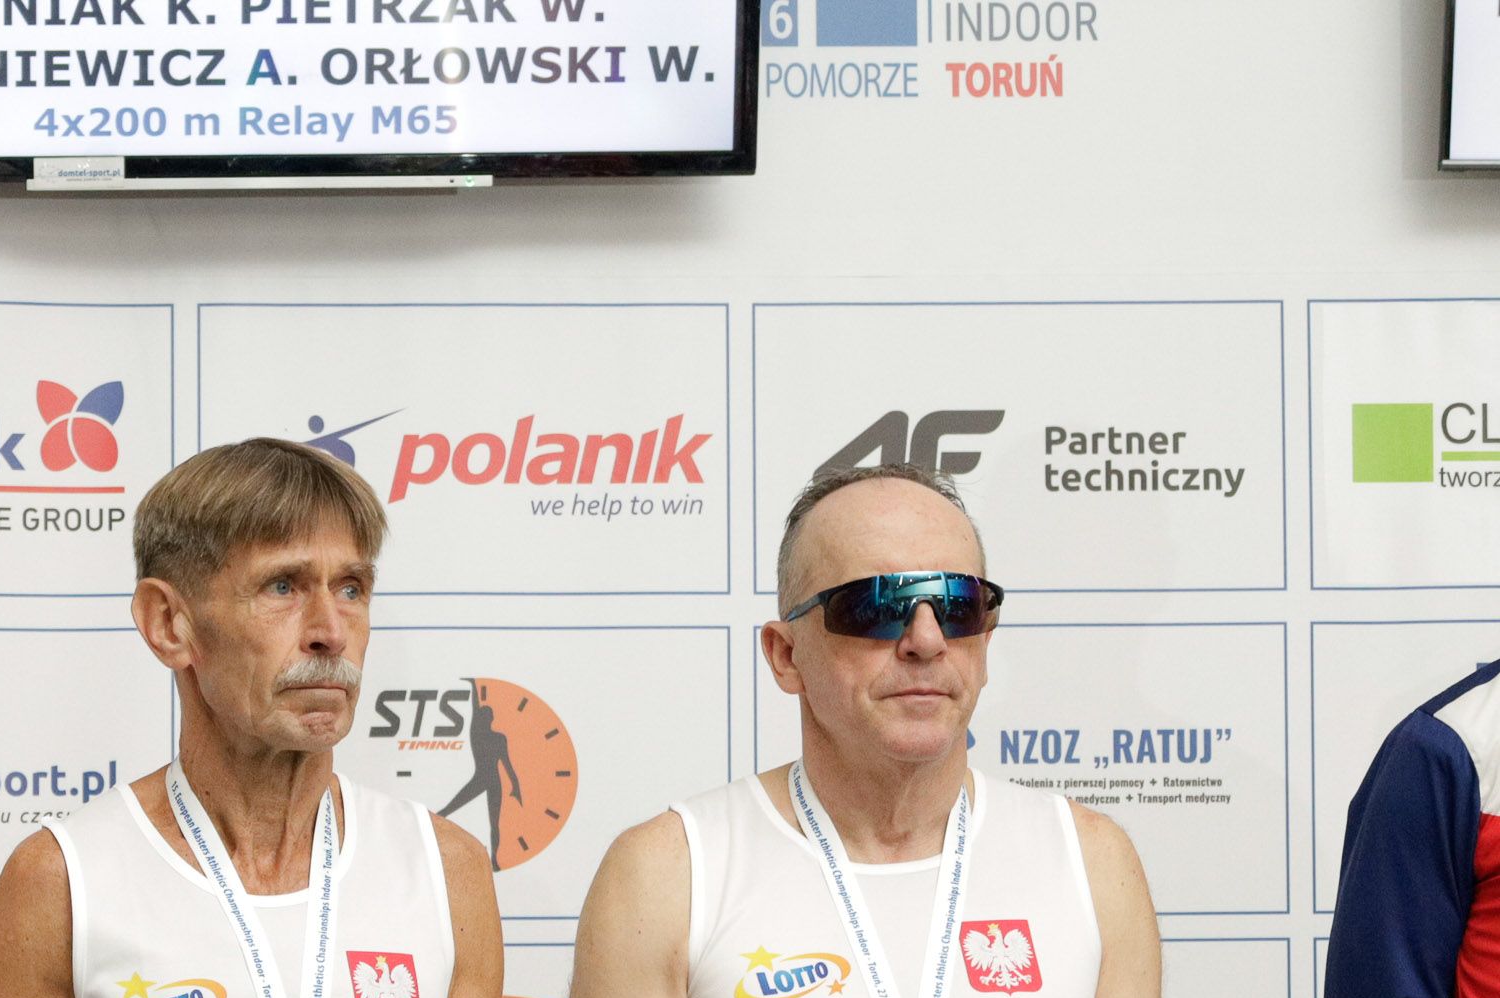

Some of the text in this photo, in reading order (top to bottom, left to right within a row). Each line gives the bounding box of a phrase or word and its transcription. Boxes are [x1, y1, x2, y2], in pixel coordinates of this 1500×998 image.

[945, 2, 1098, 42] INDOOR
[246, 49, 297, 85] A.
[320, 46, 626, 85] ORŁOWSKI
[648, 45, 715, 83] W.
[766, 54, 1063, 98] POMORZE TORUŃ
[33, 105, 458, 142] 4x200 m Relay M65
[1046, 426, 1186, 455] Partner
[388, 414, 713, 504] polanik
[1044, 461, 1246, 498] techniczny
[23, 508, 125, 531] GROUP
[531, 493, 703, 522] we help to win
[369, 689, 471, 738] STS
[398, 740, 464, 751] TIMING
[1000, 729, 1080, 764] NZOZ
[1064, 777, 1222, 790] pierwszej pomocy Ratownictwo
[1138, 793, 1182, 804] Transport
[1186, 793, 1231, 804] medyczny
[174, 793, 265, 977] European Masters Athletics Championships Indoor
[321, 875, 332, 900] Indoor
[804, 807, 870, 958] Masters Athletics Championships Indoor
[951, 863, 962, 886] Indoor
[316, 898, 330, 964] Championships
[942, 886, 959, 946] Championships
[757, 962, 828, 996] LOTTO
[936, 946, 949, 980] Athletics
